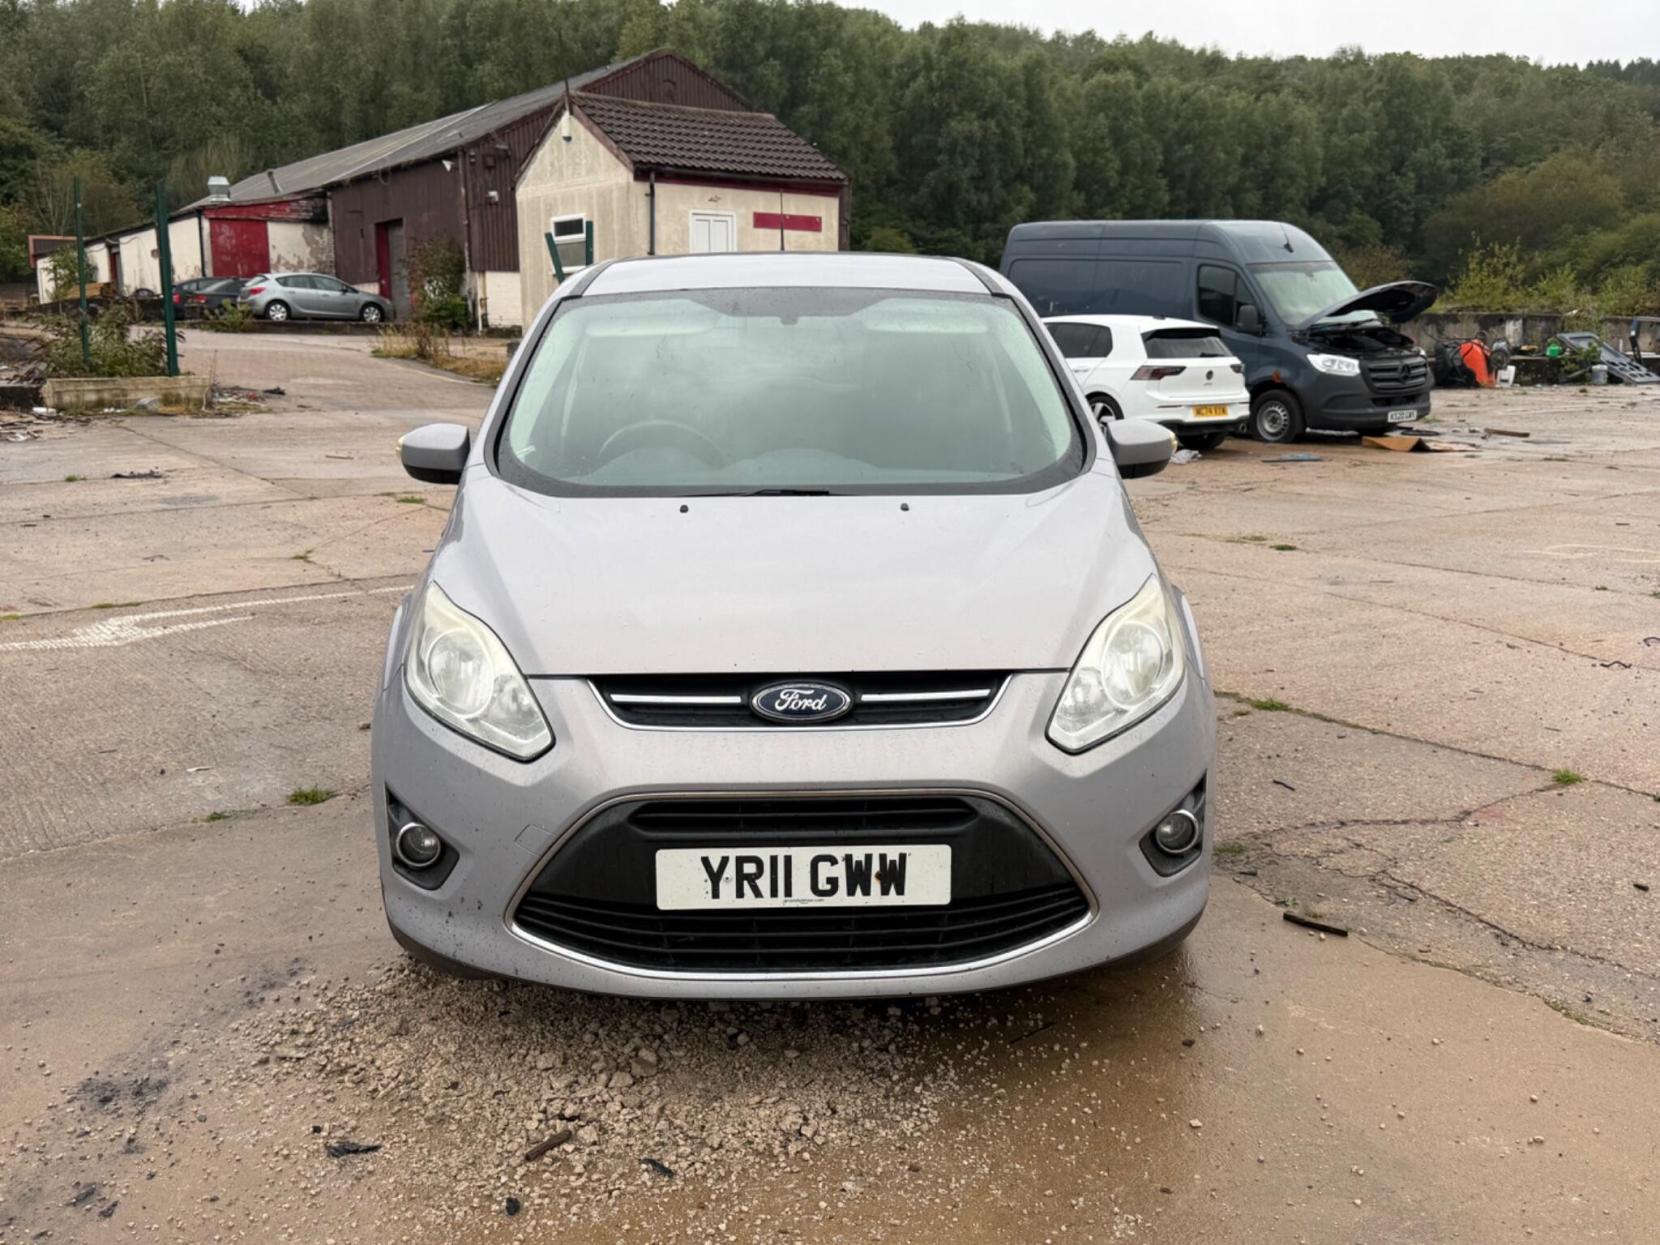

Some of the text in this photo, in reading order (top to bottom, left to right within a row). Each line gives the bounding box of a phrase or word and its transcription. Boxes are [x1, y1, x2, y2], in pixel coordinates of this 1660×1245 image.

[775, 688, 828, 711] Ford
[700, 852, 908, 900] YR11 GWW
